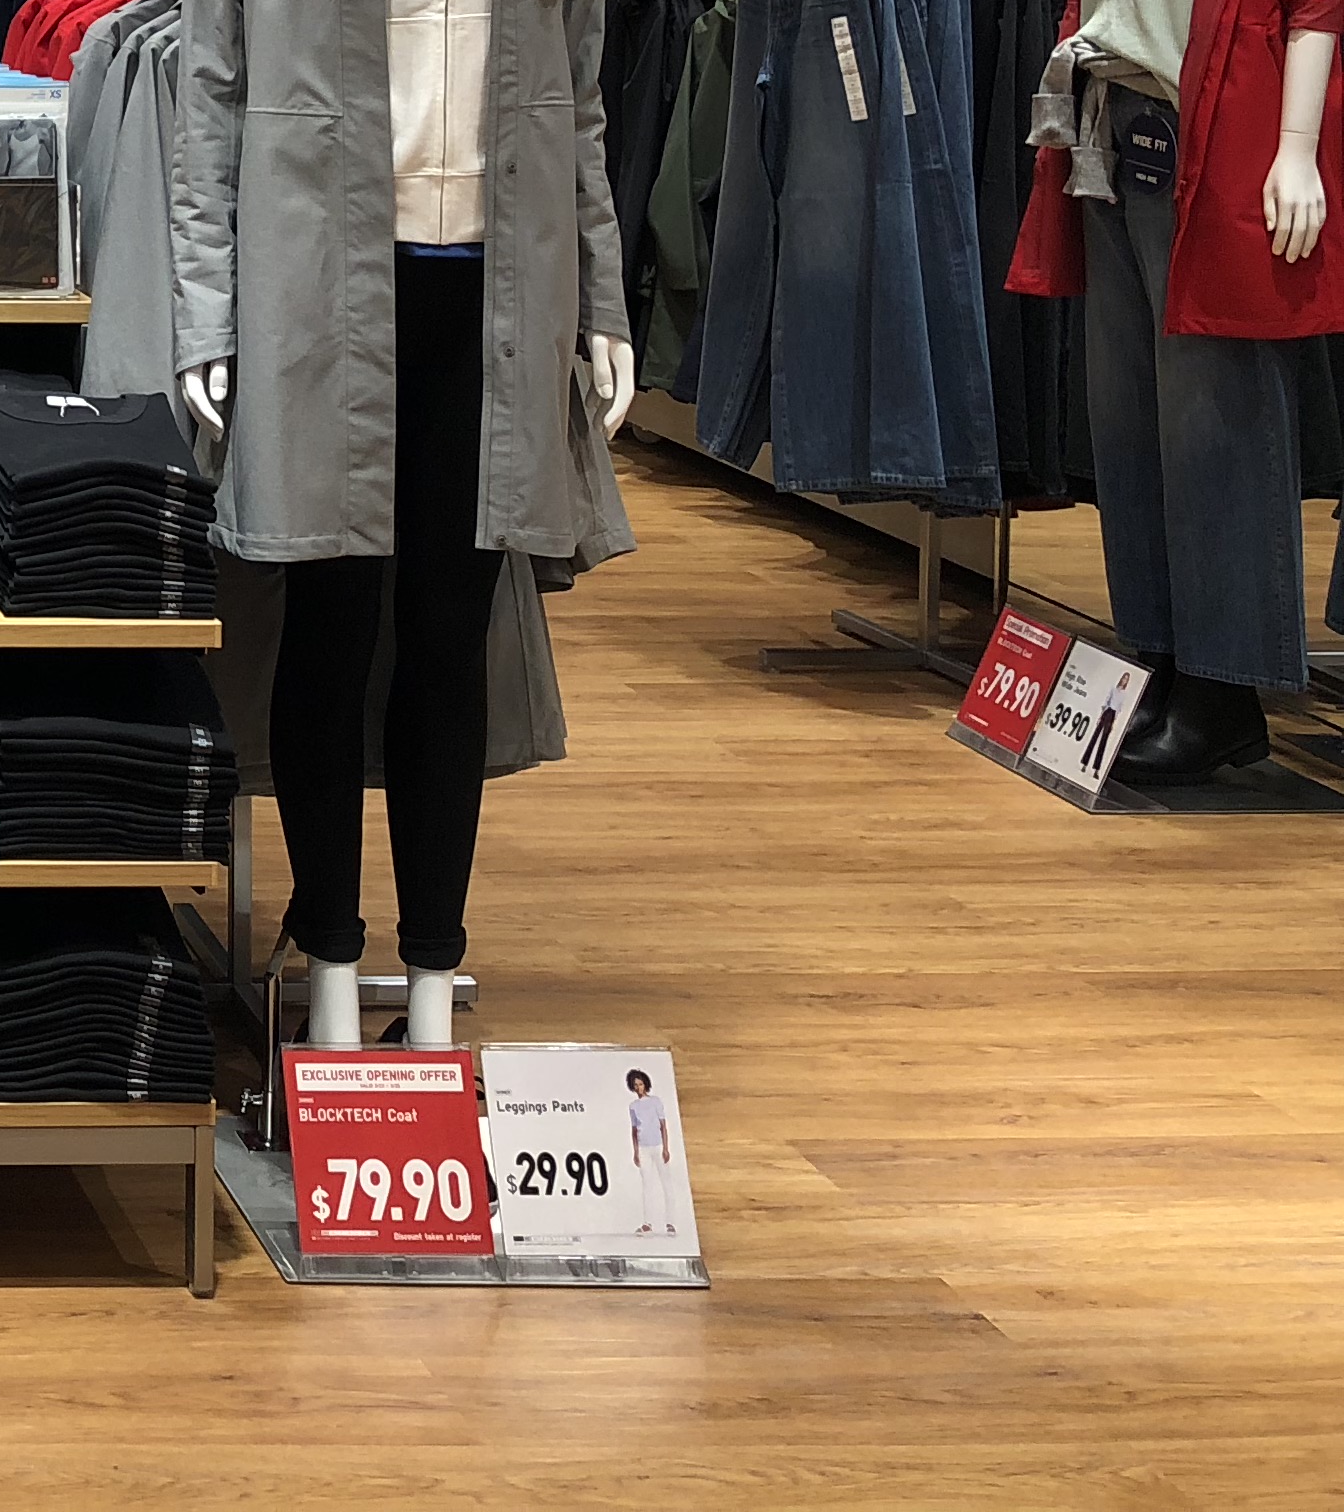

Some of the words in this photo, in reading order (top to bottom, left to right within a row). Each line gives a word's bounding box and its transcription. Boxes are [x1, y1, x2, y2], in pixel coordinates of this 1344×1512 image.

[49, 90, 61, 99] XS
[1132, 133, 1152, 148] WIDE
[1154, 139, 1167, 152] FIT
[1006, 617, 1023, 633] Special
[1024, 624, 1050, 646] Promotion
[977, 662, 1040, 718] $79.90
[1045, 702, 1091, 742] $39.90
[302, 1070, 362, 1081] EXCLUSIVE
[367, 1070, 415, 1081] OPENING
[420, 1070, 457, 1081] OFFER
[299, 1108, 382, 1122] BLOCKTECH
[387, 1108, 418, 1122] Coat
[496, 1100, 547, 1115] Leggings
[552, 1101, 585, 1112] Pants
[506, 1151, 609, 1196] $29.90
[311, 1158, 472, 1223] $79.90
[394, 1232, 422, 1241] Discount
[424, 1232, 444, 1241] taken
[446, 1233, 454, 1241] at
[455, 1232, 482, 1242] register
